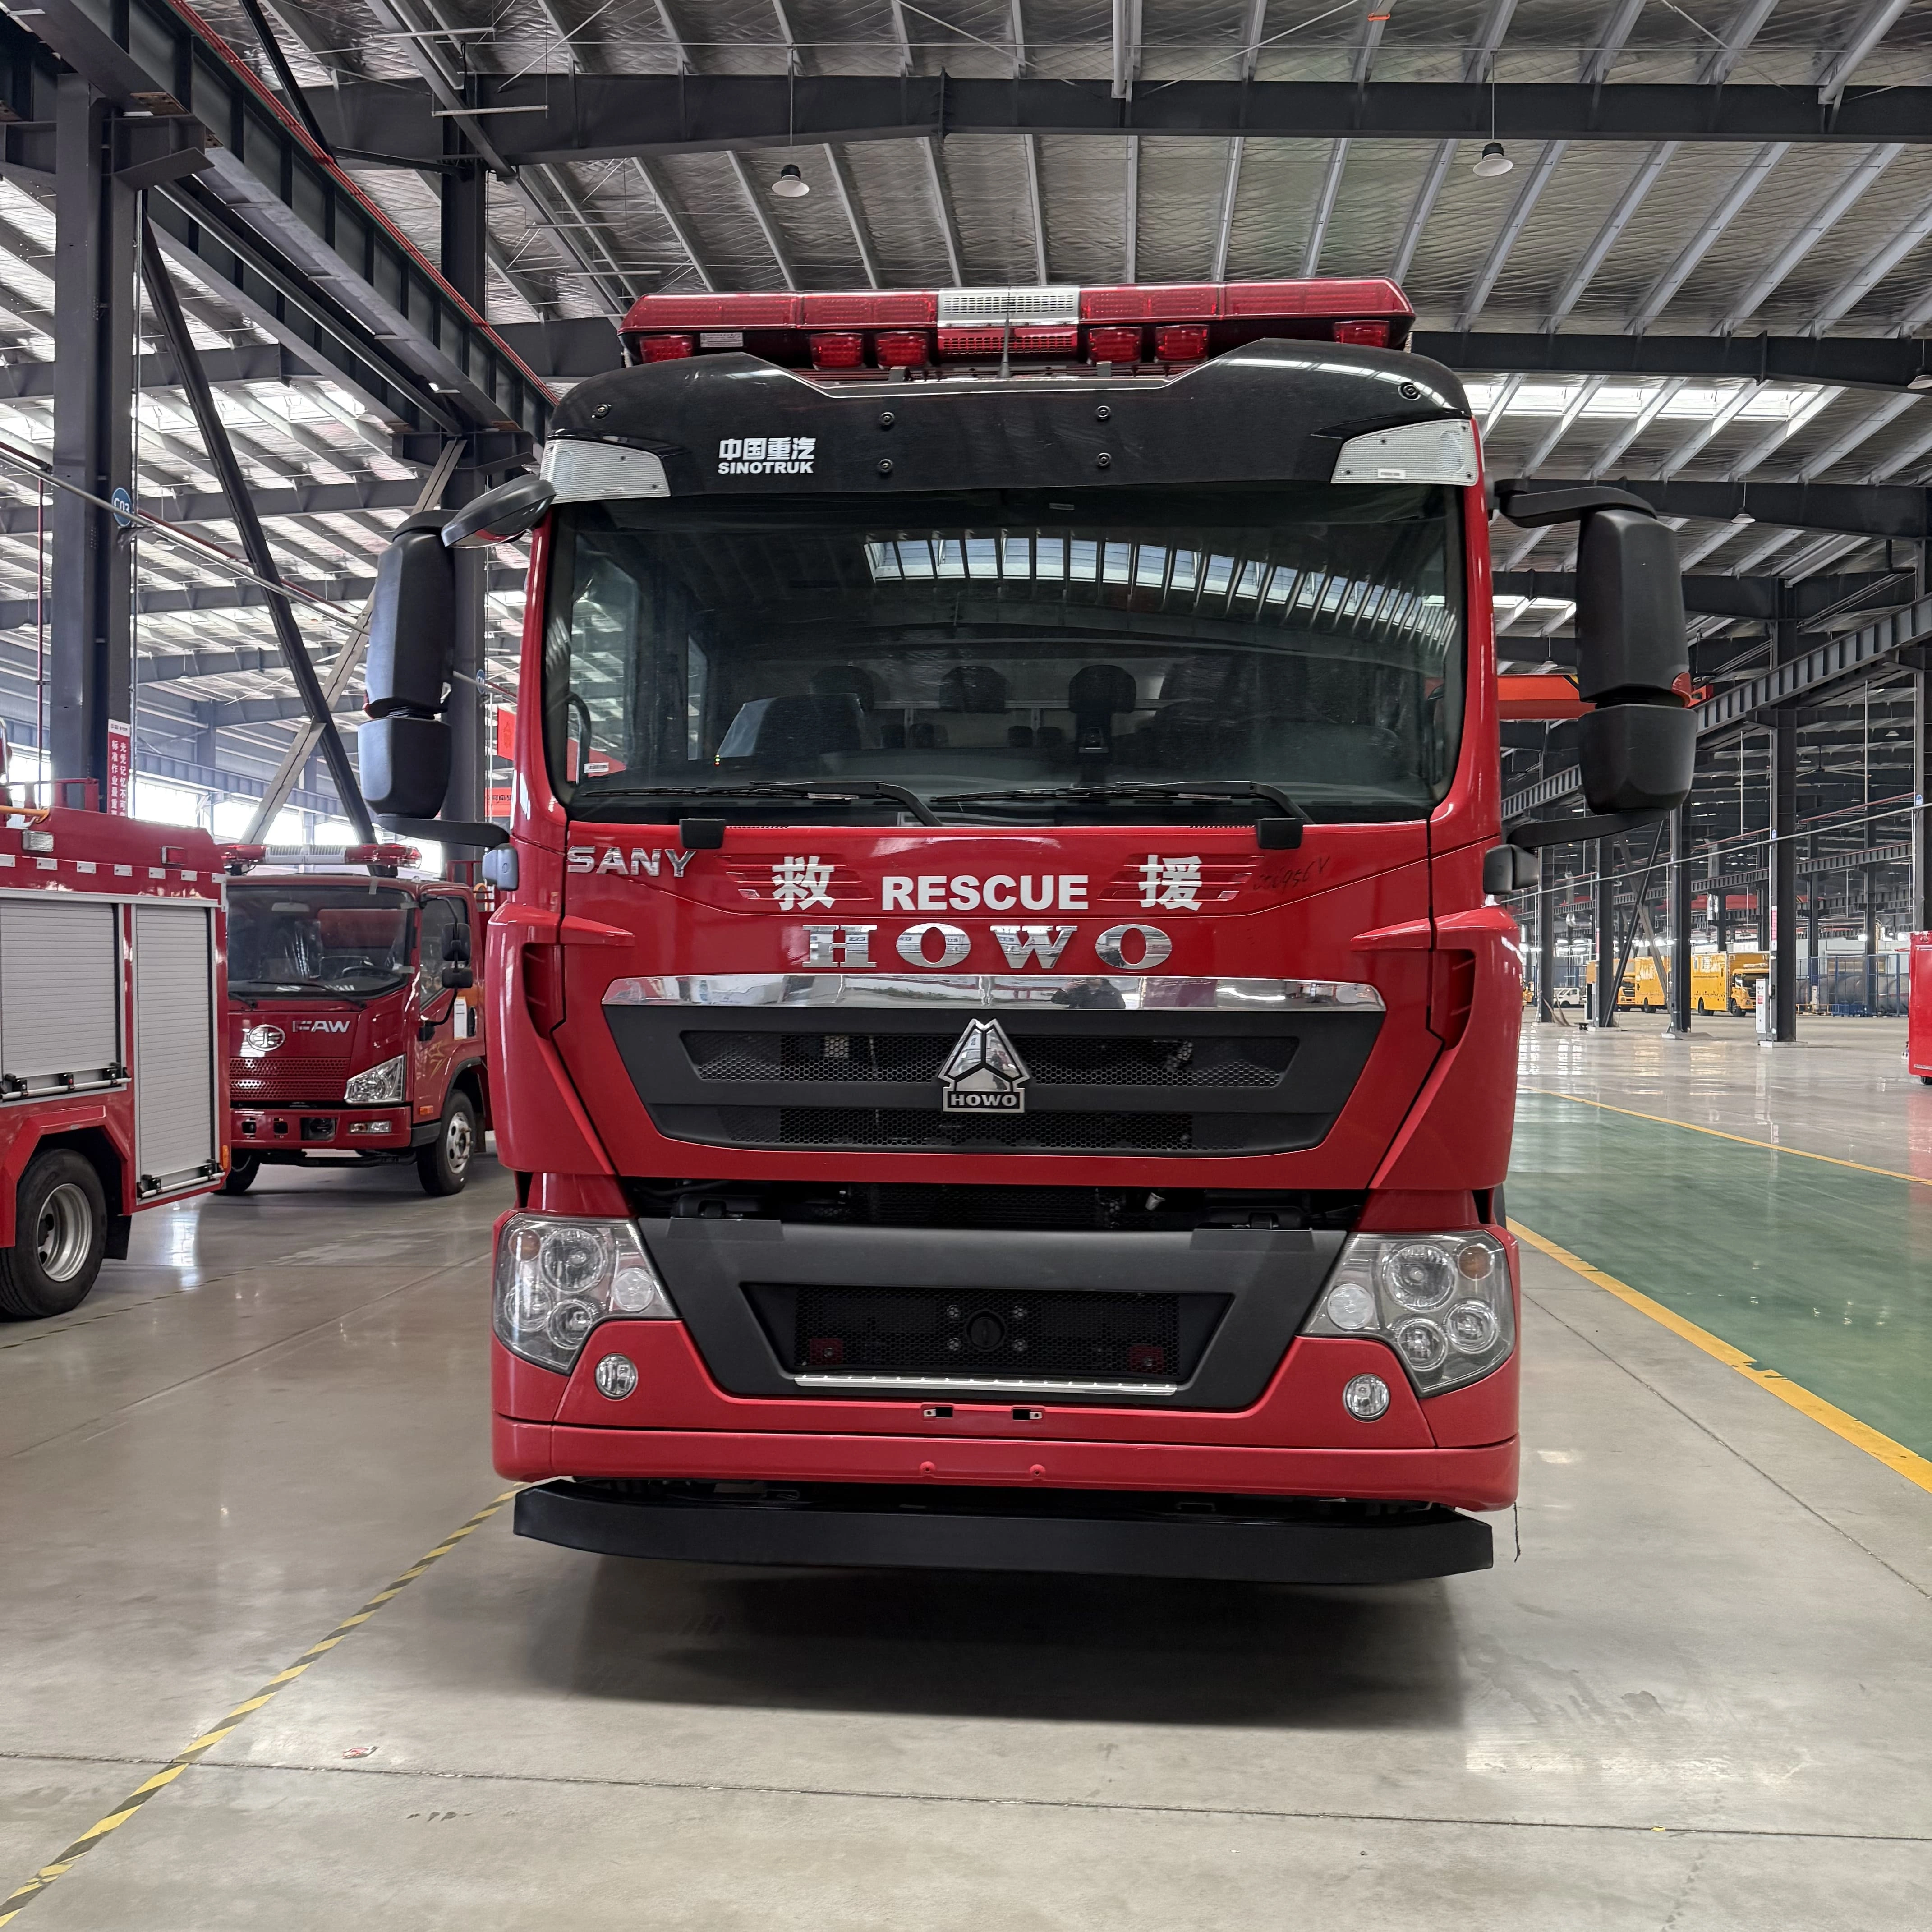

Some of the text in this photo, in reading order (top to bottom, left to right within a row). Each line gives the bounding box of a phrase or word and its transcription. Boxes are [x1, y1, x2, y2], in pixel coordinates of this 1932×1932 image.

[718, 437, 816, 460] 中国重汽
[718, 461, 814, 474] SINOTRUK
[567, 845, 697, 878] SANY
[772, 855, 835, 911] 救
[882, 875, 1089, 911] RESCUE
[1138, 854, 1203, 911] 援
[802, 923, 1173, 970] HOWO
[292, 1020, 350, 1033] FAW
[950, 1094, 1017, 1107] HOWO
